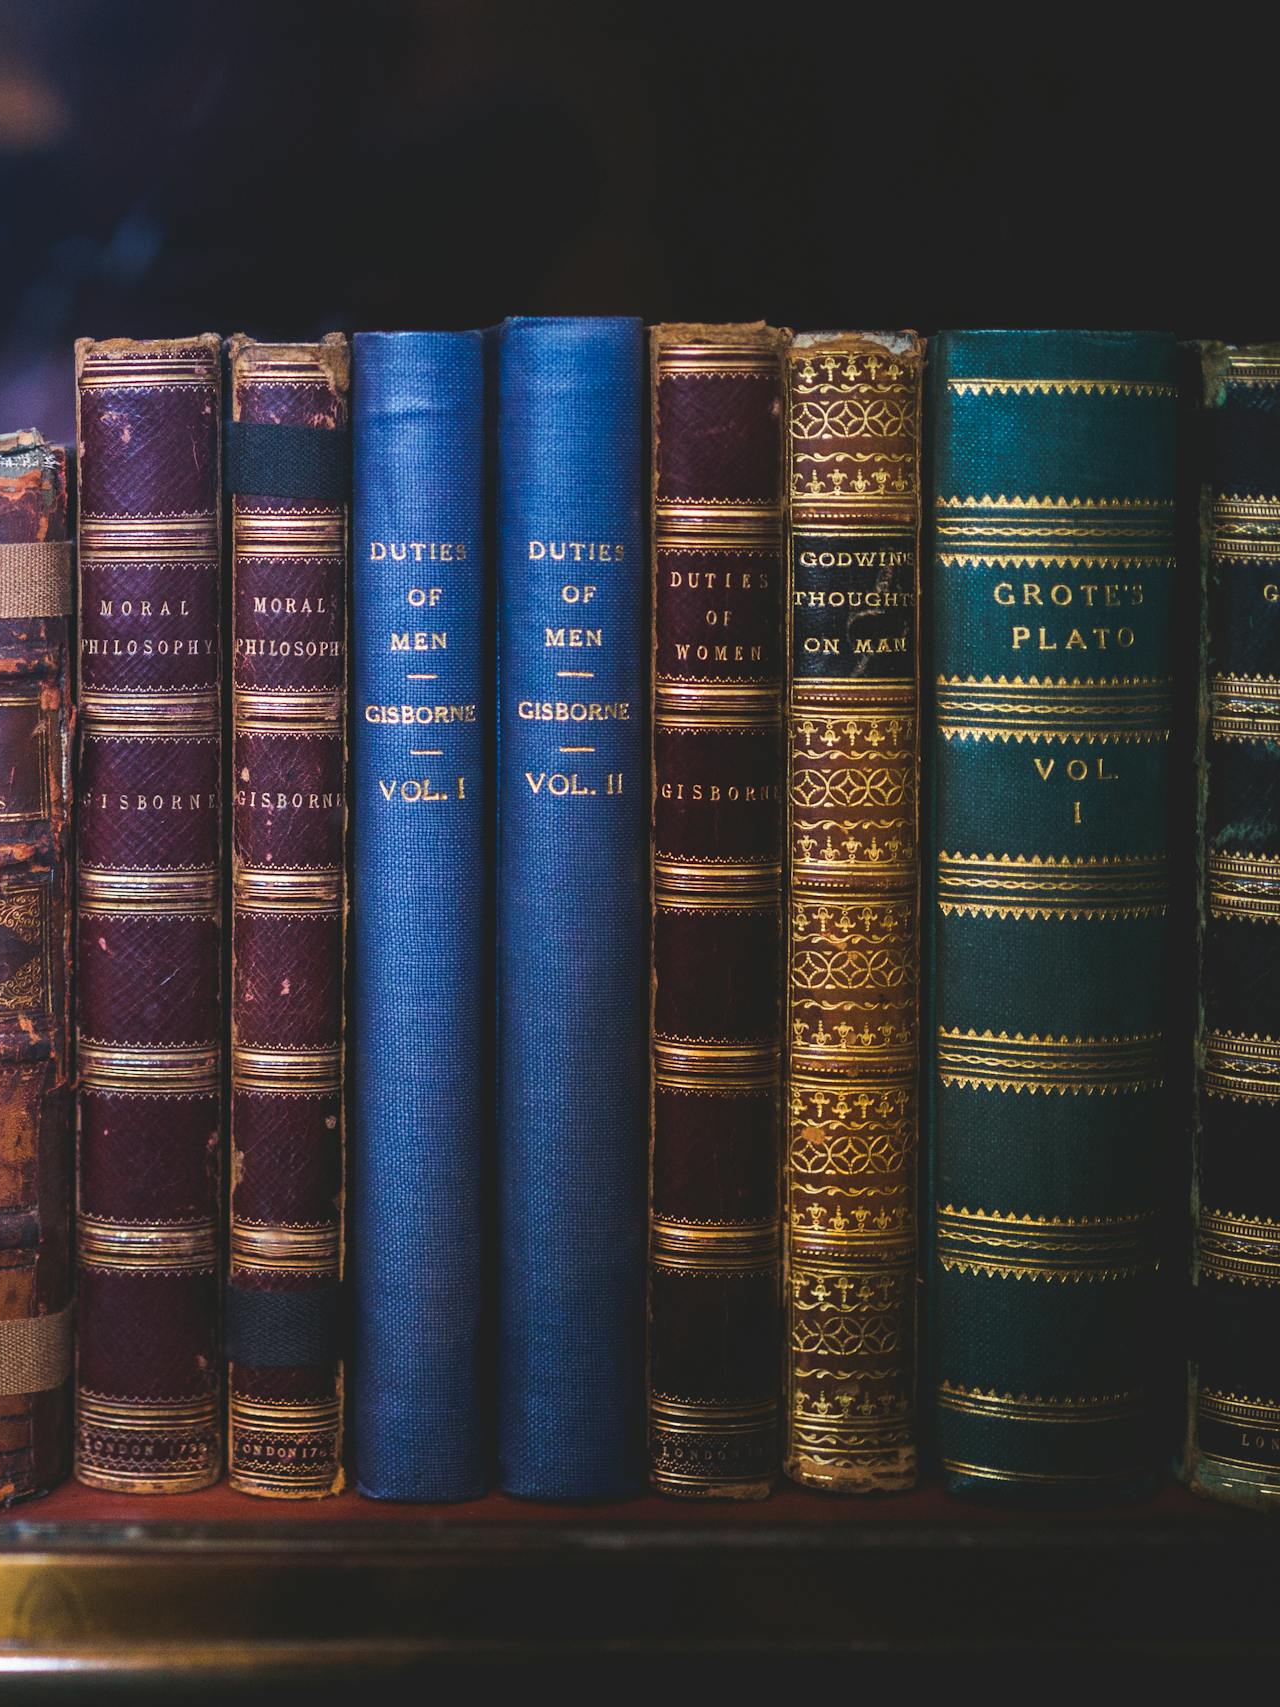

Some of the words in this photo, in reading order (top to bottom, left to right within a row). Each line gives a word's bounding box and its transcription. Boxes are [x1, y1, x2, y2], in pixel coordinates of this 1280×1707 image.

[370, 542, 466, 561] DUTIES
[528, 541, 625, 561] DUTIES
[799, 551, 914, 567] GODWIN'S
[670, 572, 768, 588] DUTIES
[406, 588, 442, 606] OF
[561, 585, 596, 603] OF
[993, 583, 1144, 607] GROTE'S
[100, 600, 189, 616] MORAL
[253, 596, 326, 614] MORAL
[706, 610, 732, 626] OF
[390, 632, 447, 650] MEN
[545, 628, 602, 647] MEN
[803, 637, 840, 653] ON
[853, 637, 907, 653] MAN
[1012, 626, 1135, 650] PLATO
[365, 704, 476, 724] GISBORNE
[518, 701, 630, 721] GISBORNE
[1034, 758, 1119, 781] VOL.
[379, 779, 448, 801] VOL.
[457, 776, 465, 799] I
[525, 772, 596, 795] VOL.
[606, 772, 623, 794] II
[1074, 801, 1081, 823] I
